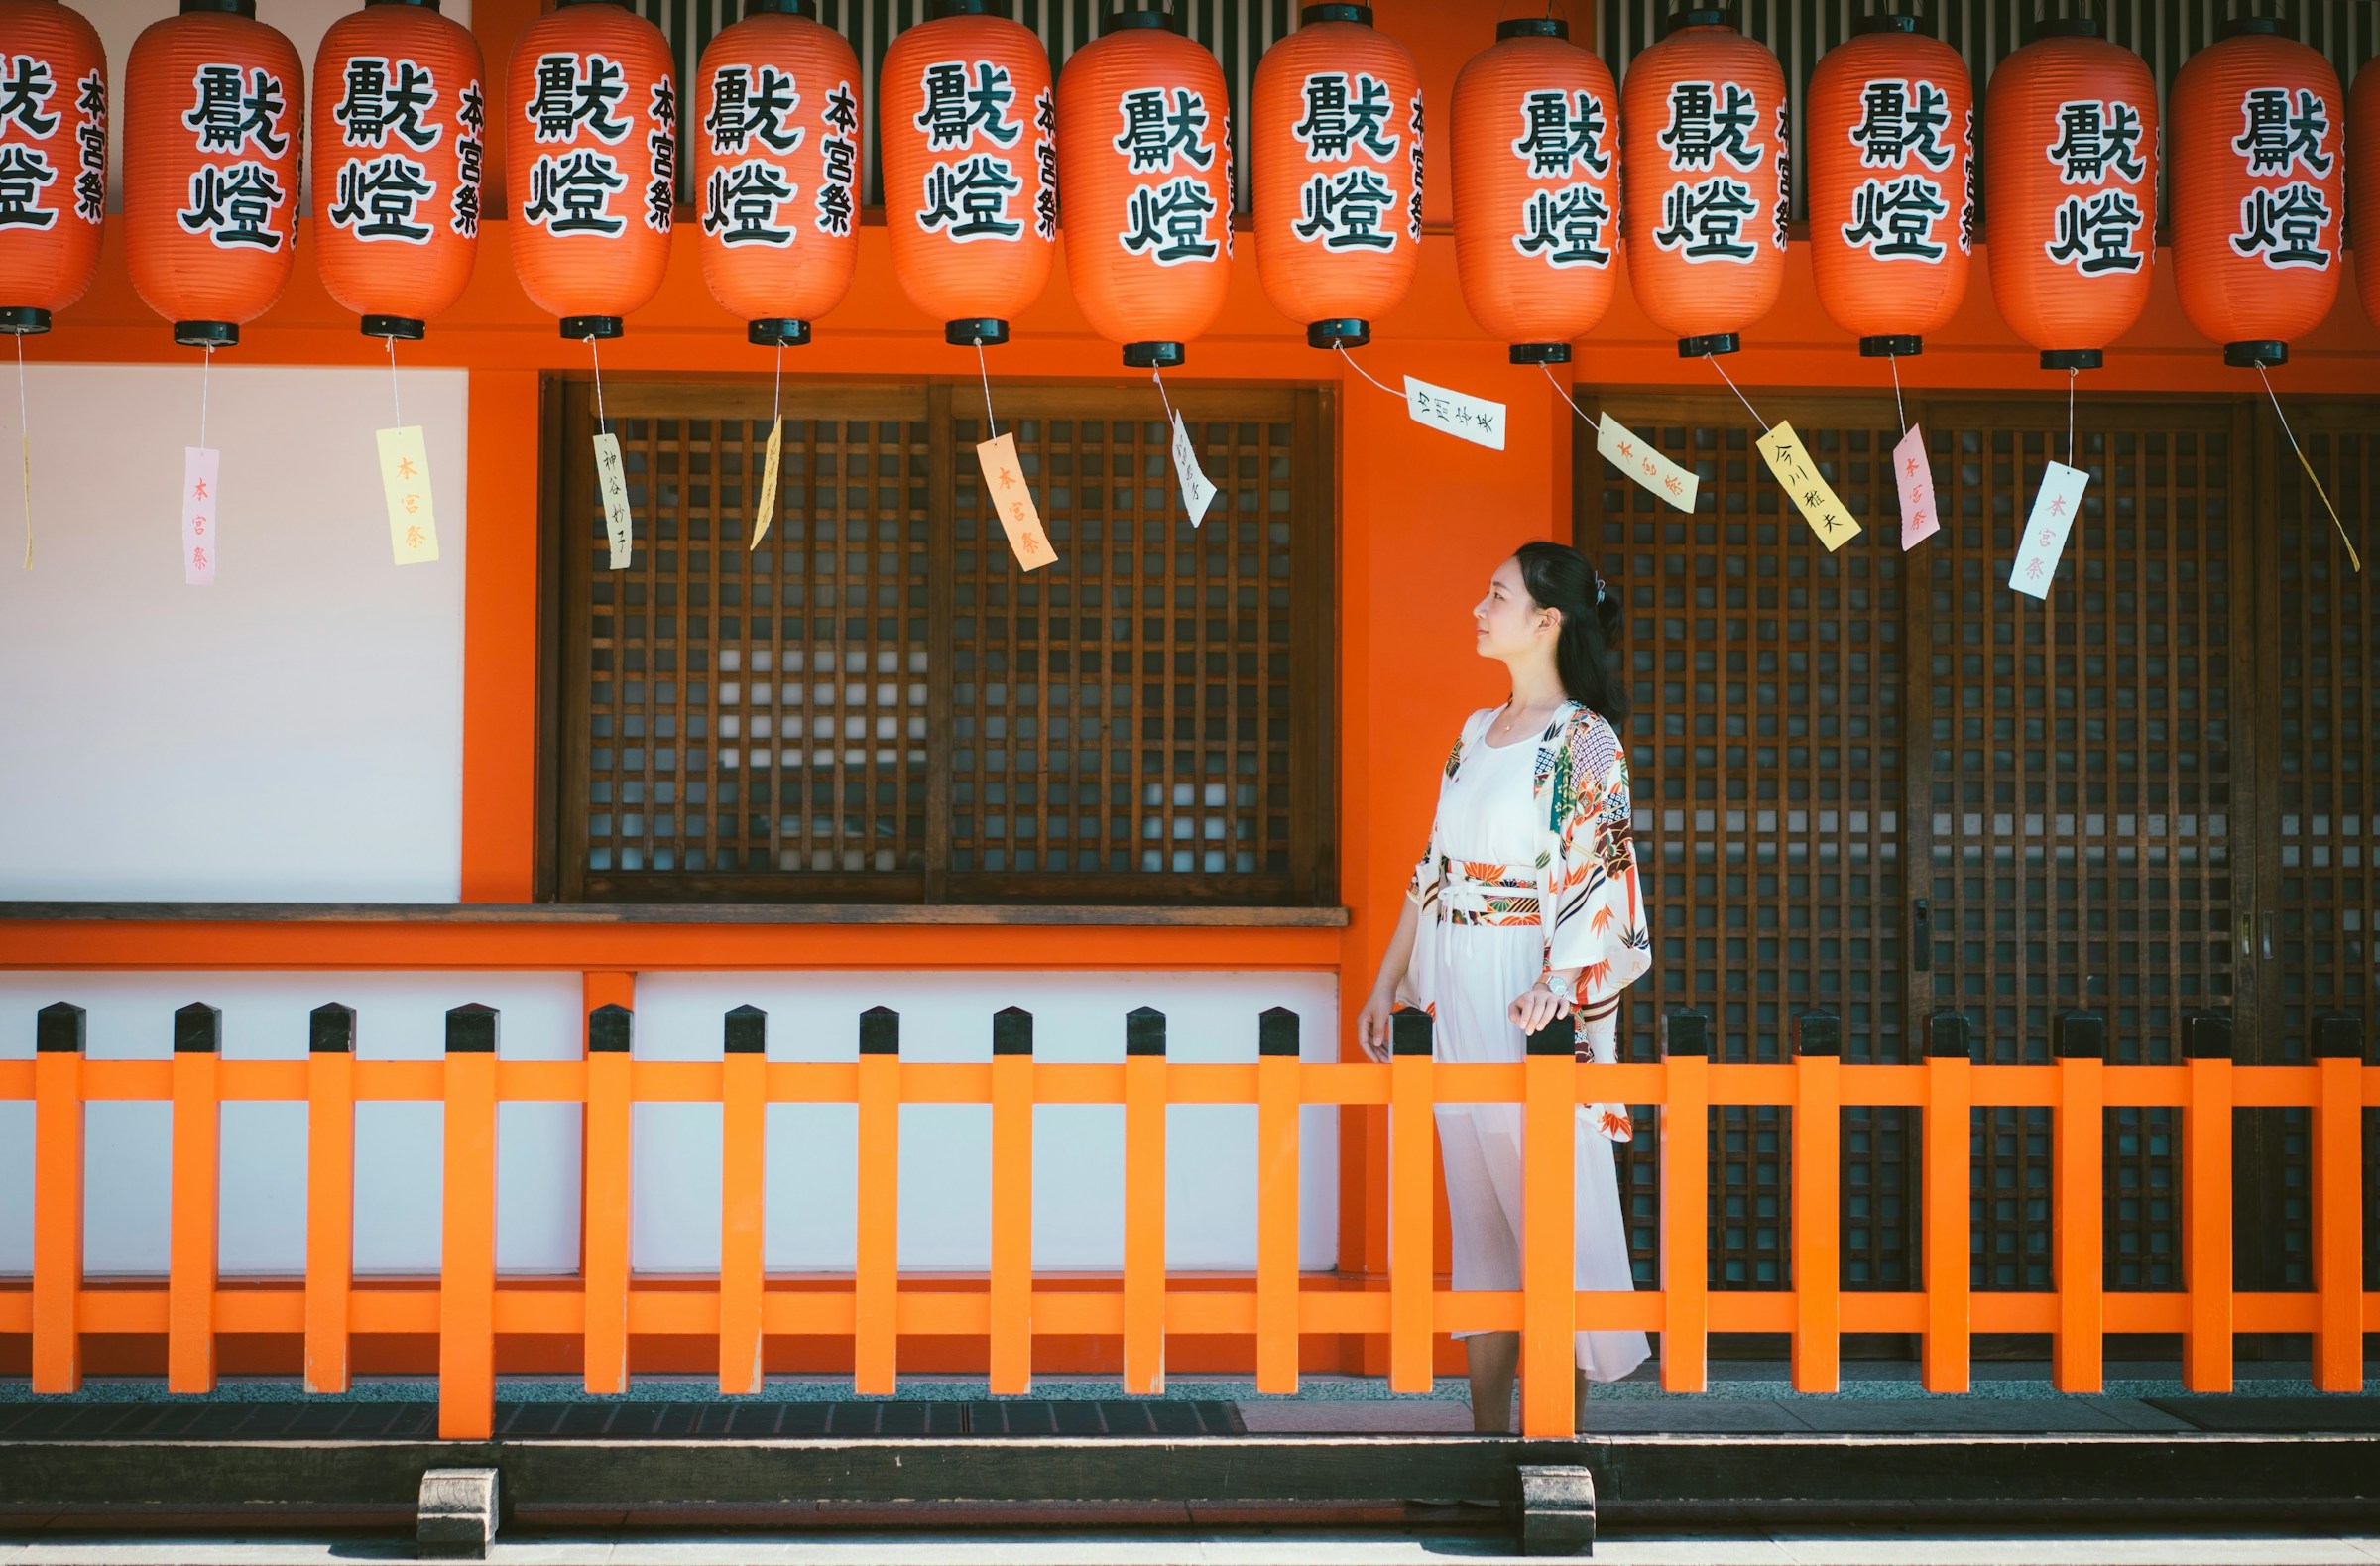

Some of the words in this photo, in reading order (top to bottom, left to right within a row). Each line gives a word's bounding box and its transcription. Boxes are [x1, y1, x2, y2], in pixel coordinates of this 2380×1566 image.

[75, 70, 106, 222] 本宮祭
[452, 81, 484, 236] 本宮祭
[646, 75, 674, 233] 本宮祭
[817, 83, 857, 235] 本宮祭
[396, 456, 426, 549] 本宮祭
[998, 467, 1039, 554] 本宮祭
[1616, 440, 1683, 496] 本宮祭
[1904, 458, 1927, 531] 本宮祭
[191, 477, 208, 571] 本宮祭
[2024, 493, 2067, 581] 本宮祭
